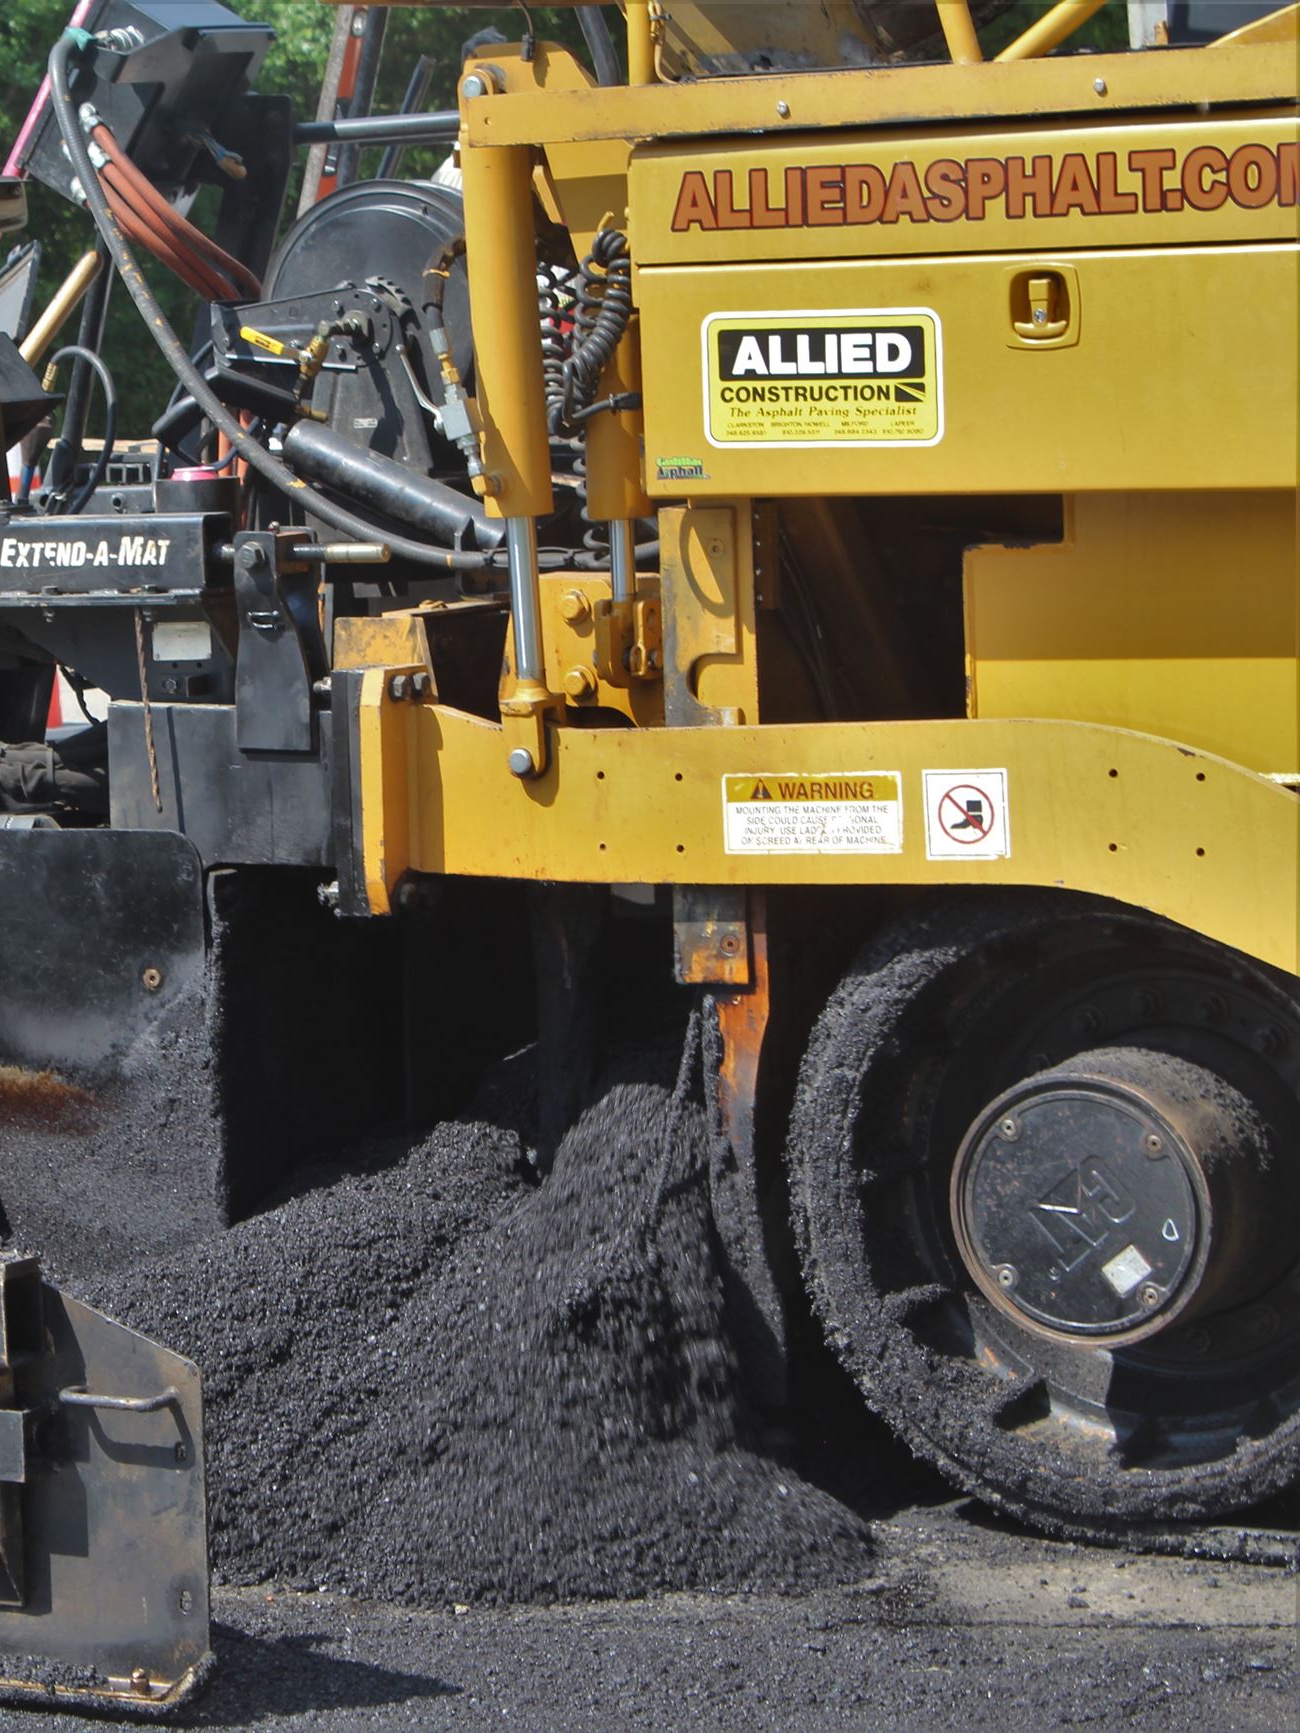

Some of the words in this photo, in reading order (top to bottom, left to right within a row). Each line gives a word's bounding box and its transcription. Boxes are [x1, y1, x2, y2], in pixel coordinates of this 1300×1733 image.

[731, 332, 912, 376] ALLIED
[720, 384, 890, 403] CONSTRUCTION
[729, 407, 751, 418] The
[756, 406, 803, 421] Asphalt
[808, 405, 850, 418] Paving
[855, 405, 917, 418] Specialist
[0, 536, 170, 567] EXTEND-A-MAT
[778, 781, 874, 800] WARNING
[736, 805, 781, 815] MOUNTING
[784, 805, 800, 814] THE
[803, 804, 842, 814] MACHINE
[845, 804, 869, 814] FROM
[872, 804, 888, 814] THE
[747, 816, 765, 826] SIDE
[768, 816, 798, 825] COULD
[780, 826, 797, 835] USE
[756, 836, 791, 846] SCREED
[806, 835, 830, 845] REAR
[832, 836, 843, 845] OF
[846, 835, 887, 845] MACHINE
